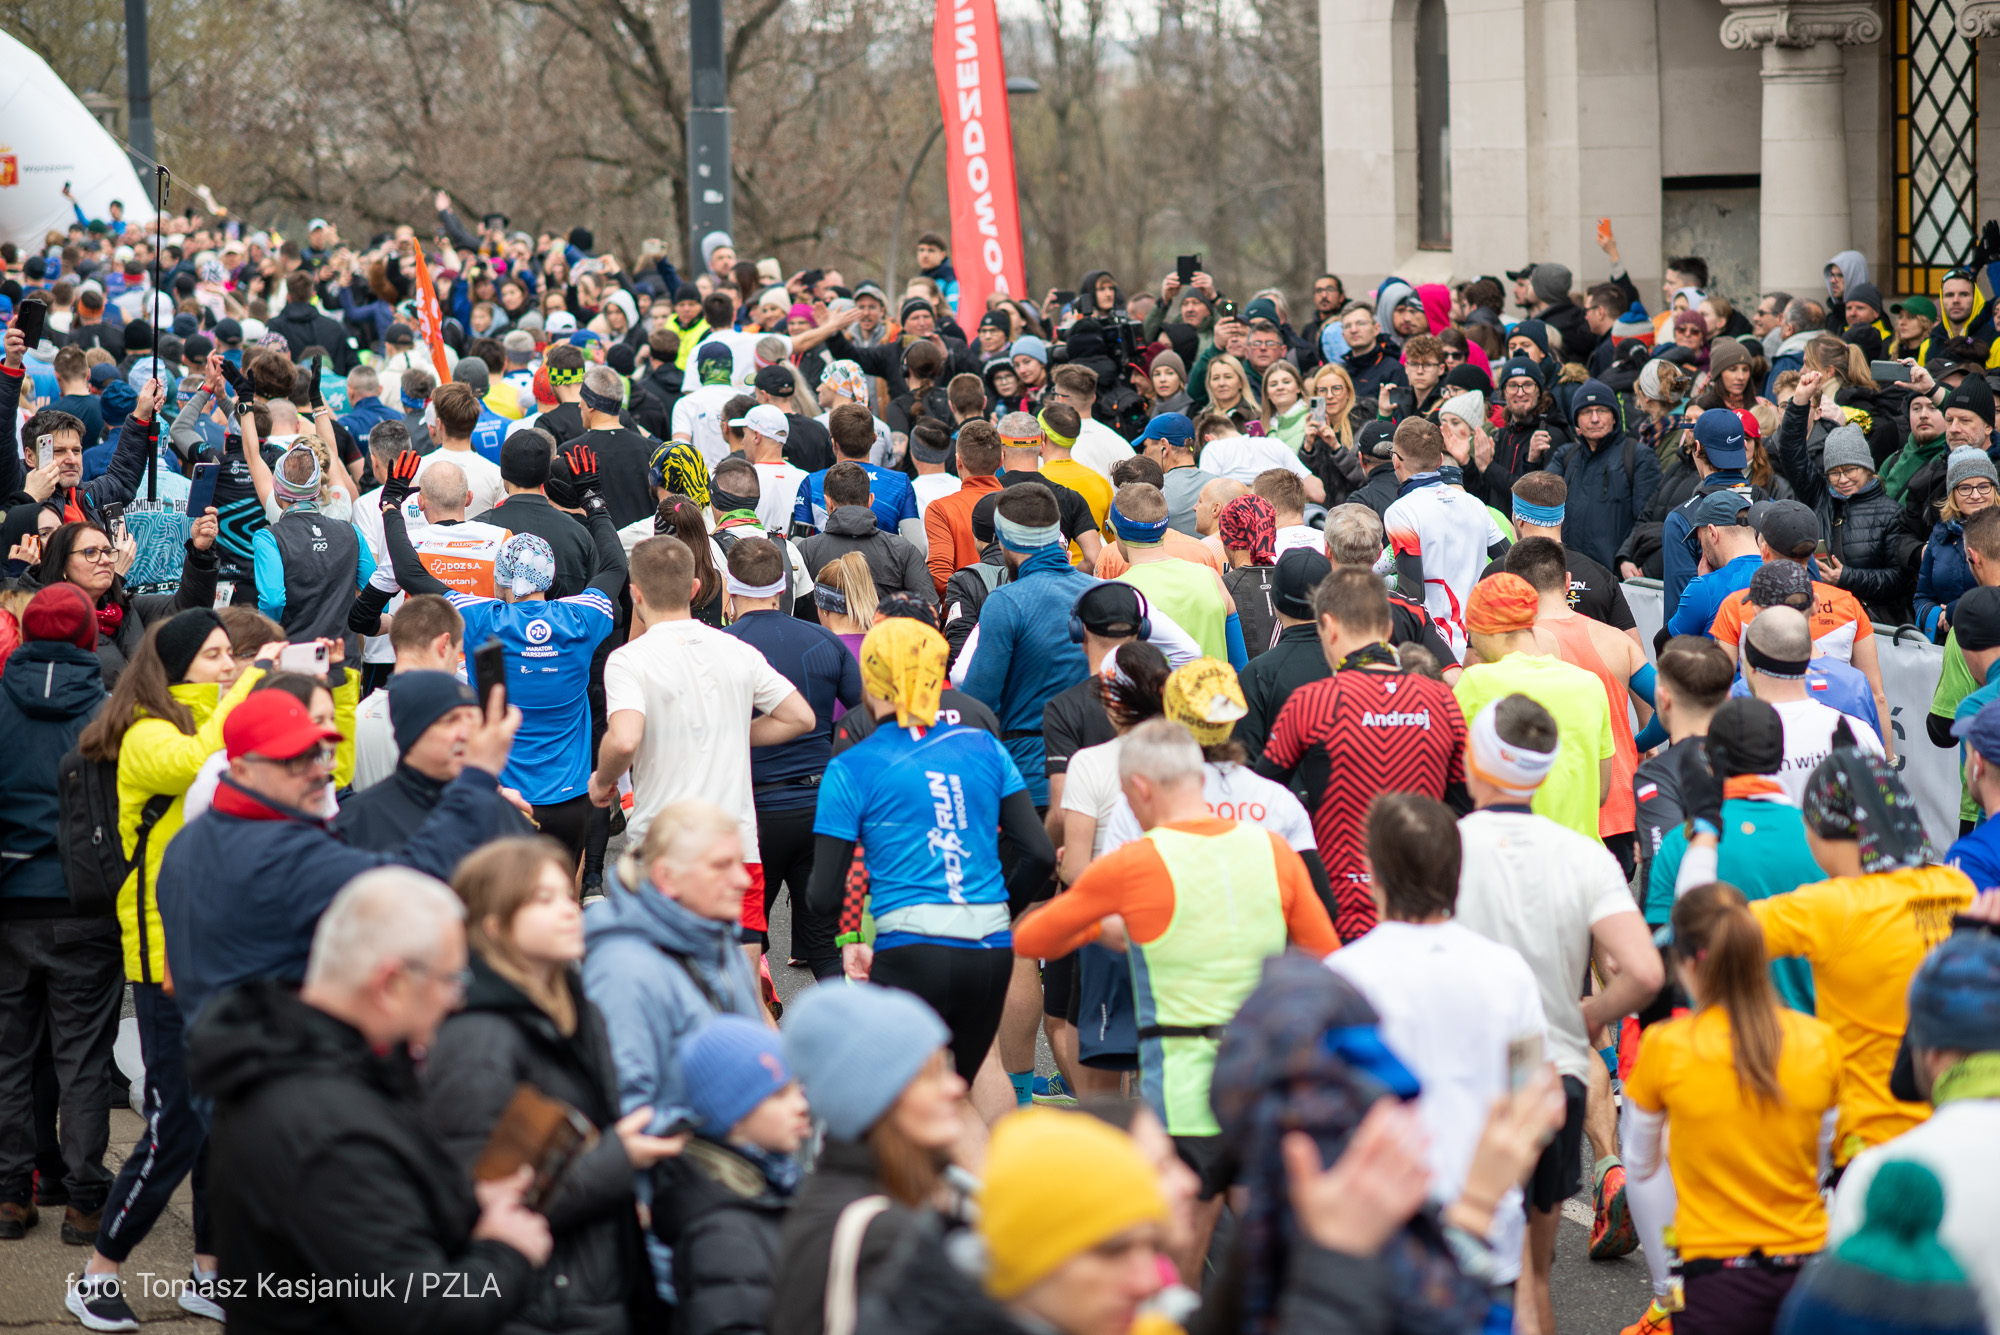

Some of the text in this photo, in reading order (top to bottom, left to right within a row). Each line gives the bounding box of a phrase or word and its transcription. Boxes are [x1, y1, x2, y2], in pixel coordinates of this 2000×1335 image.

[447, 562, 482, 570] DOZ S.A.
[531, 626, 546, 638] PZU
[1362, 708, 1431, 731] Andrzej
[925, 770, 956, 832] RUN
